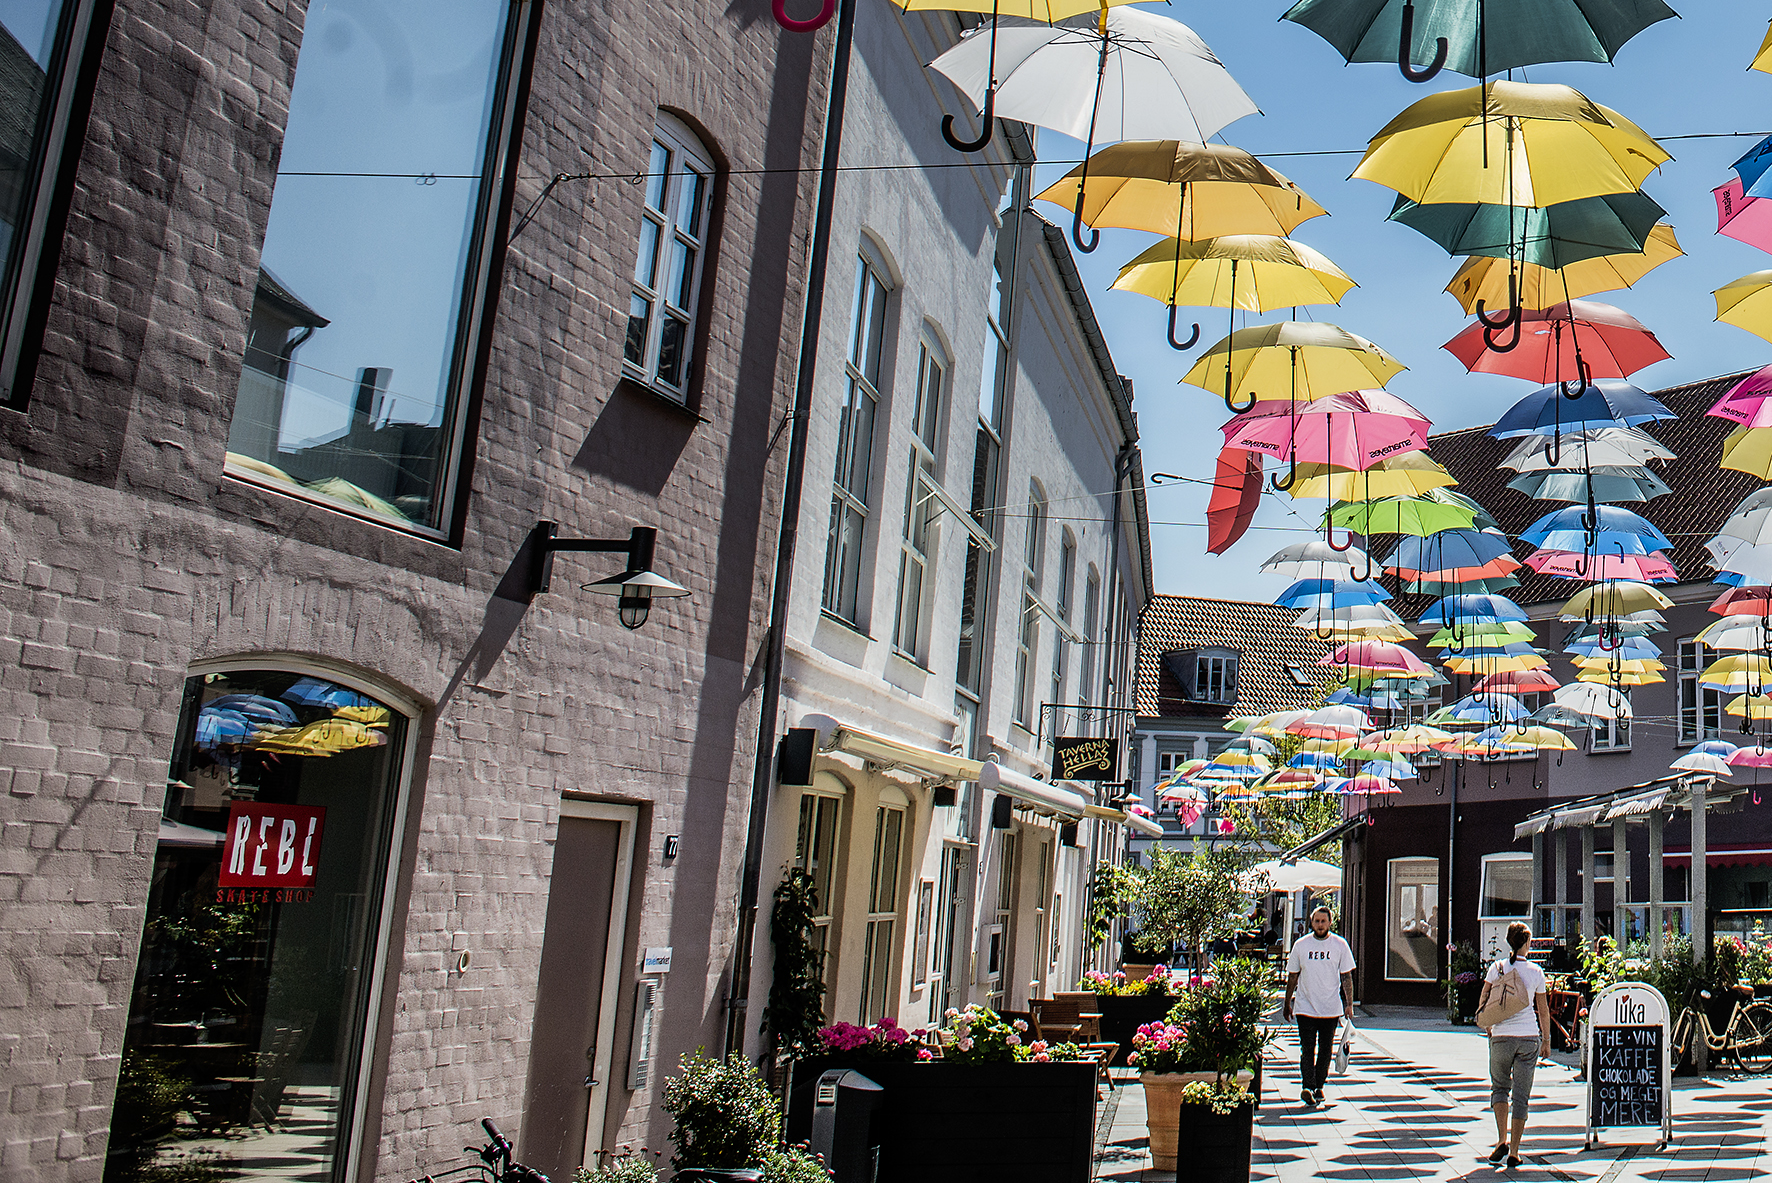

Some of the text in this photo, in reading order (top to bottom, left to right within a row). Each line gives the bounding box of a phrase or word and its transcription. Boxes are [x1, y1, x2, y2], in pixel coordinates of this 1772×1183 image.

[1057, 739, 1111, 760] TAVERNA
[1062, 748, 1109, 769] HELLAS
[229, 815, 317, 876] REBL
[216, 889, 314, 903] SKATE SHOP
[1308, 951, 1330, 960] REBL
[1615, 998, 1645, 1024] luka
[1595, 1030, 1656, 1047] THE VIN
[1600, 1048, 1657, 1070] KAFFE
[1599, 1068, 1656, 1085] CHOKOLADE
[1600, 1086, 1661, 1102] OG MEGET
[1601, 1101, 1659, 1125] MERE
